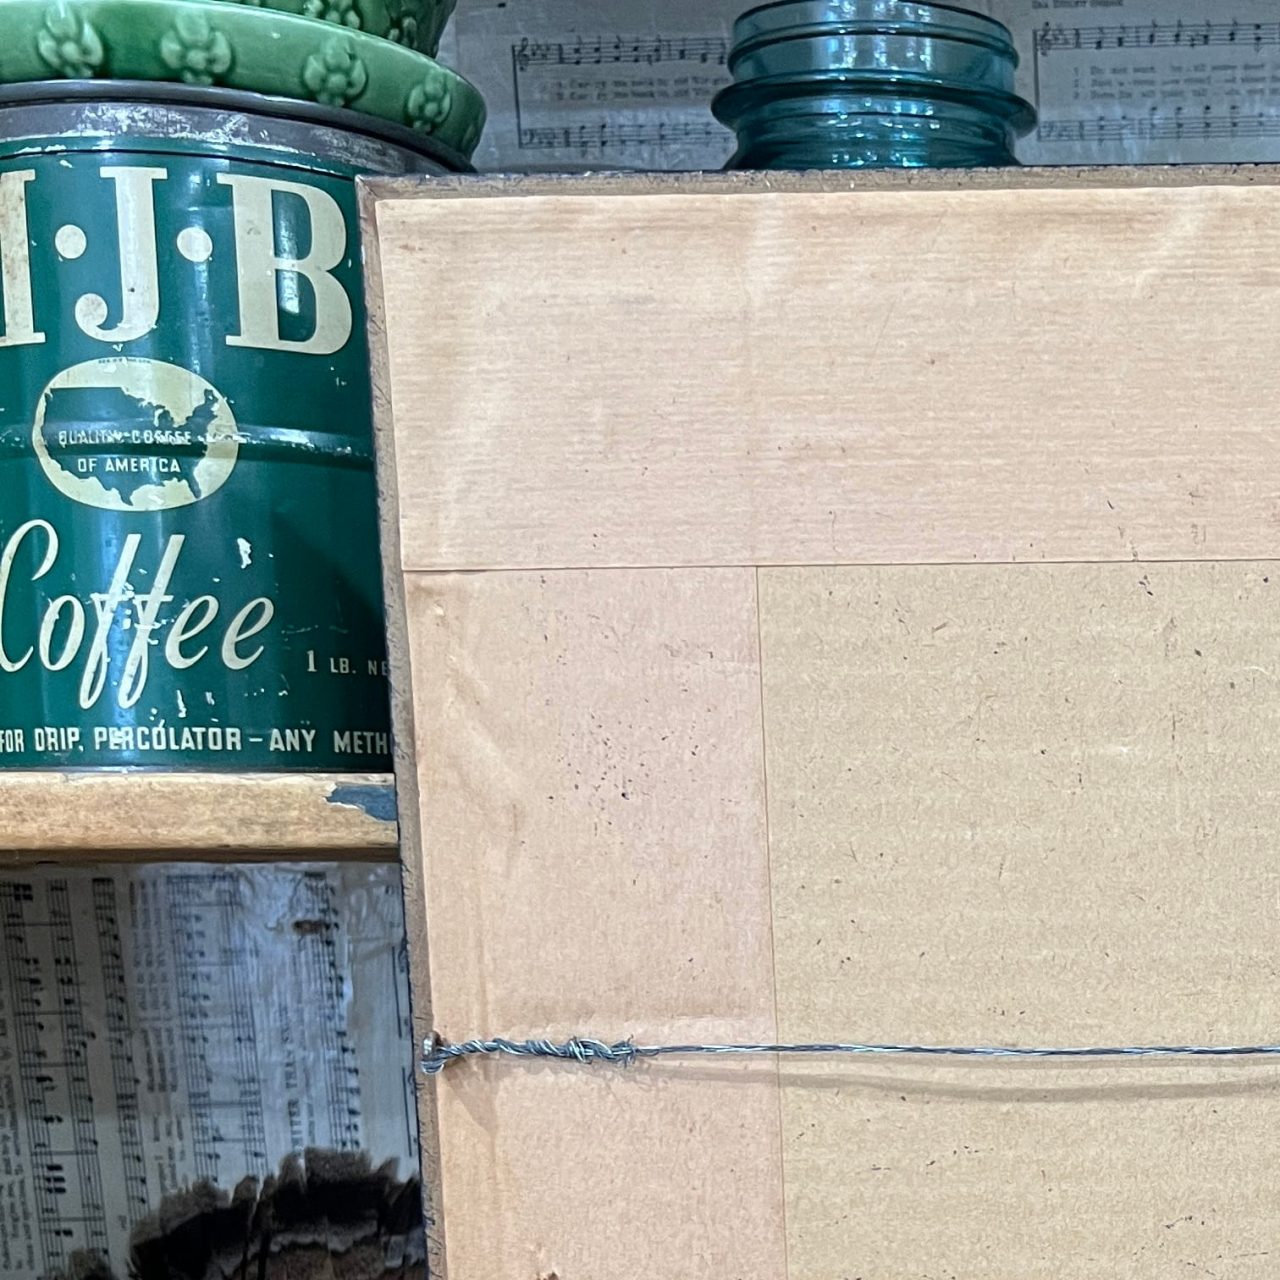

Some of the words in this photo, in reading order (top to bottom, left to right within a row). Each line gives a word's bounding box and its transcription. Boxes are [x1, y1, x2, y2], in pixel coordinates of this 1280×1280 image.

[77, 458, 98, 473] OF
[105, 457, 181, 473] AMERICA
[0, 519, 275, 710] Coffee
[306, 650, 318, 673] 1
[330, 657, 357, 675] LB.
[94, 726, 242, 751] PERCOLATOR
[269, 728, 317, 752] ANY
[333, 730, 391, 755] METH
